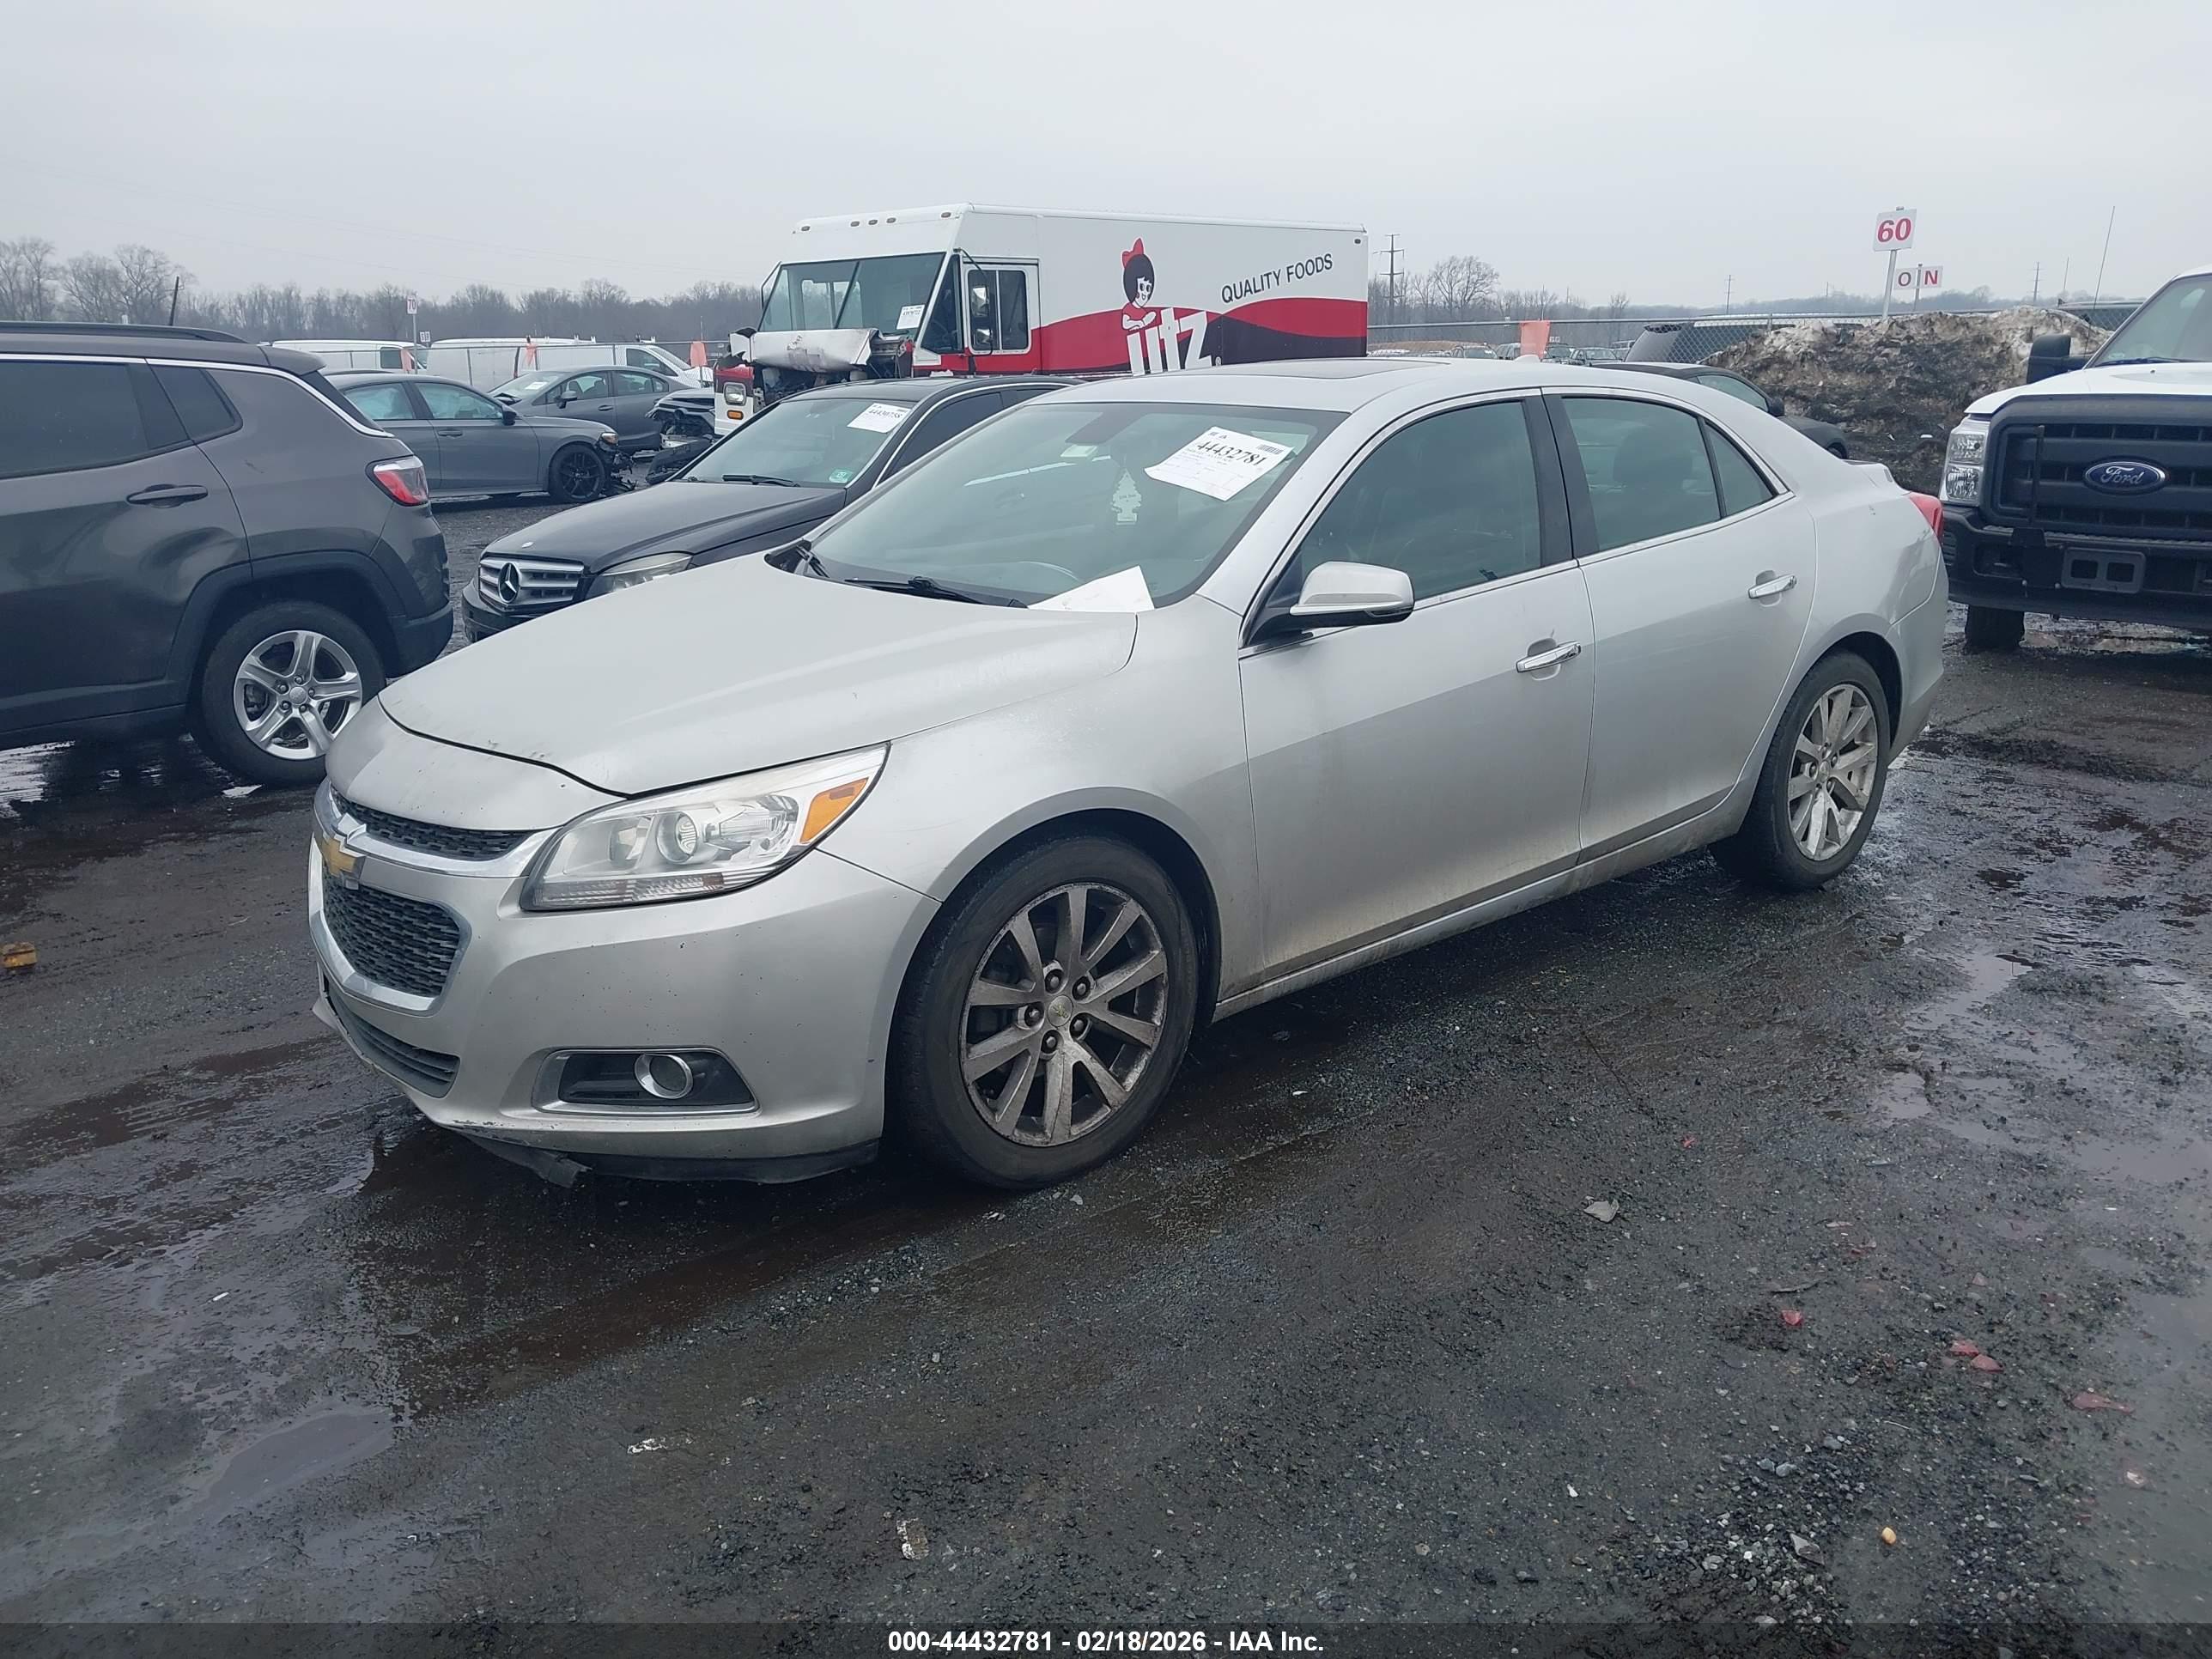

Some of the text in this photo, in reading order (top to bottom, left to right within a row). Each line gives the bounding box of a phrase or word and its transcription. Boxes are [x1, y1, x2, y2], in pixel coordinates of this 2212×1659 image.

[1877, 218, 1911, 242] 60
[1221, 253, 1333, 303] QUALITY FOODS
[1197, 441, 1267, 466] 44432781
[2100, 465, 2145, 485] Ford
